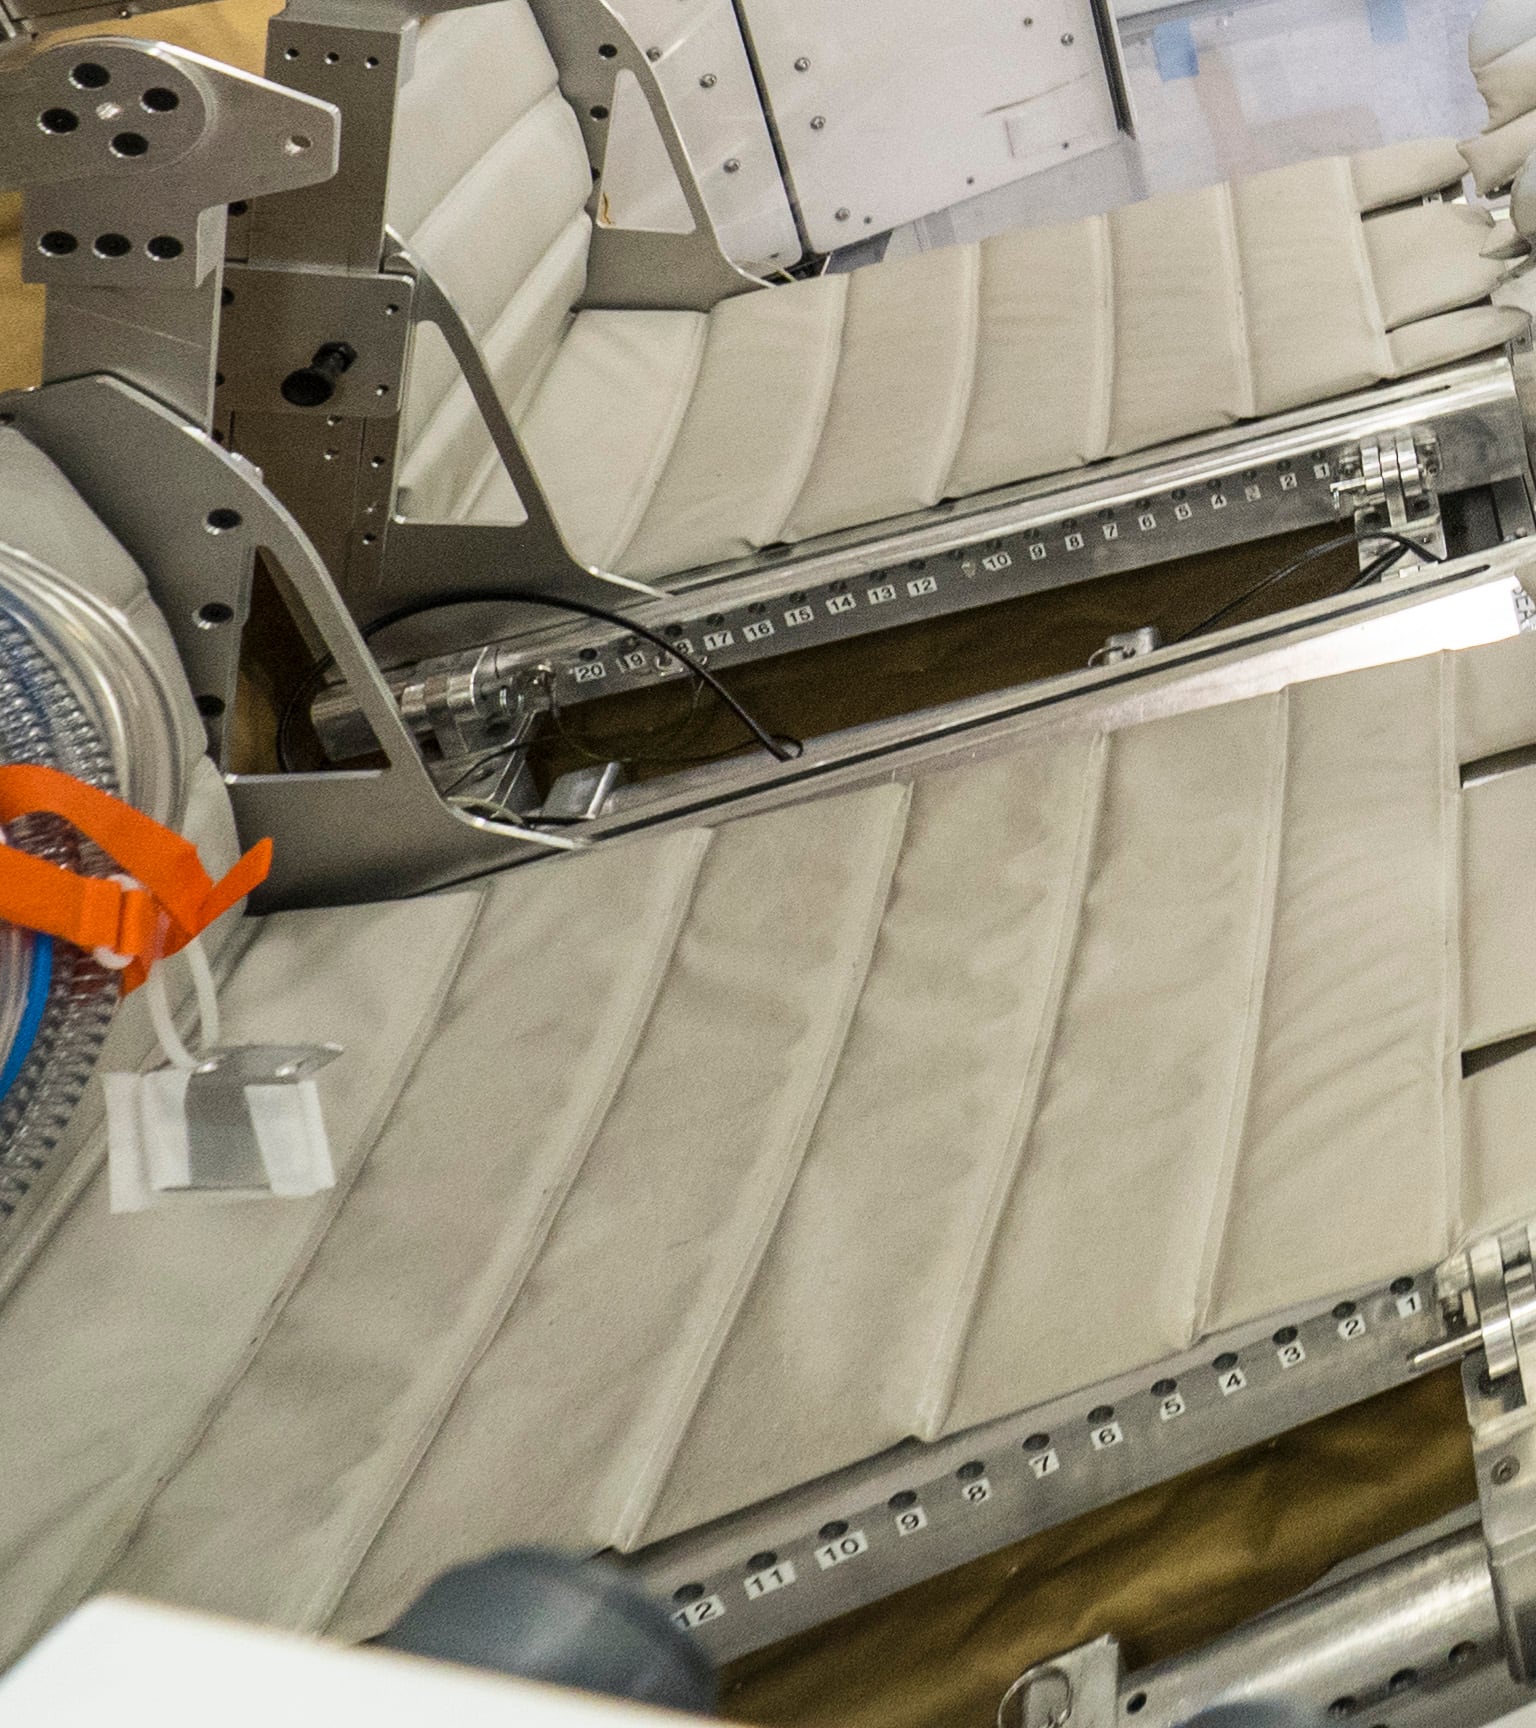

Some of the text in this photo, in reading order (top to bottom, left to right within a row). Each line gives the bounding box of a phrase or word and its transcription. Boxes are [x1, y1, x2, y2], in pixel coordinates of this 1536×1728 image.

[578, 664, 603, 680] 20
[622, 653, 643, 669] 19
[707, 633, 728, 648] 17
[749, 623, 771, 639] 16
[788, 608, 811, 623] 15
[831, 597, 852, 611] 14
[871, 587, 893, 601] 13
[912, 579, 933, 594] 12
[988, 554, 1008, 569] 10
[1032, 545, 1043, 558] 9
[1069, 535, 1080, 548] 8
[1106, 525, 1116, 539] 7
[1141, 515, 1152, 529] 6
[1178, 505, 1189, 518] 5
[1214, 495, 1224, 507] 4
[1283, 475, 1293, 487] 2
[674, 1297, 1417, 1629] 12 11 10 9 8 7 6 5 4 3 2 1
